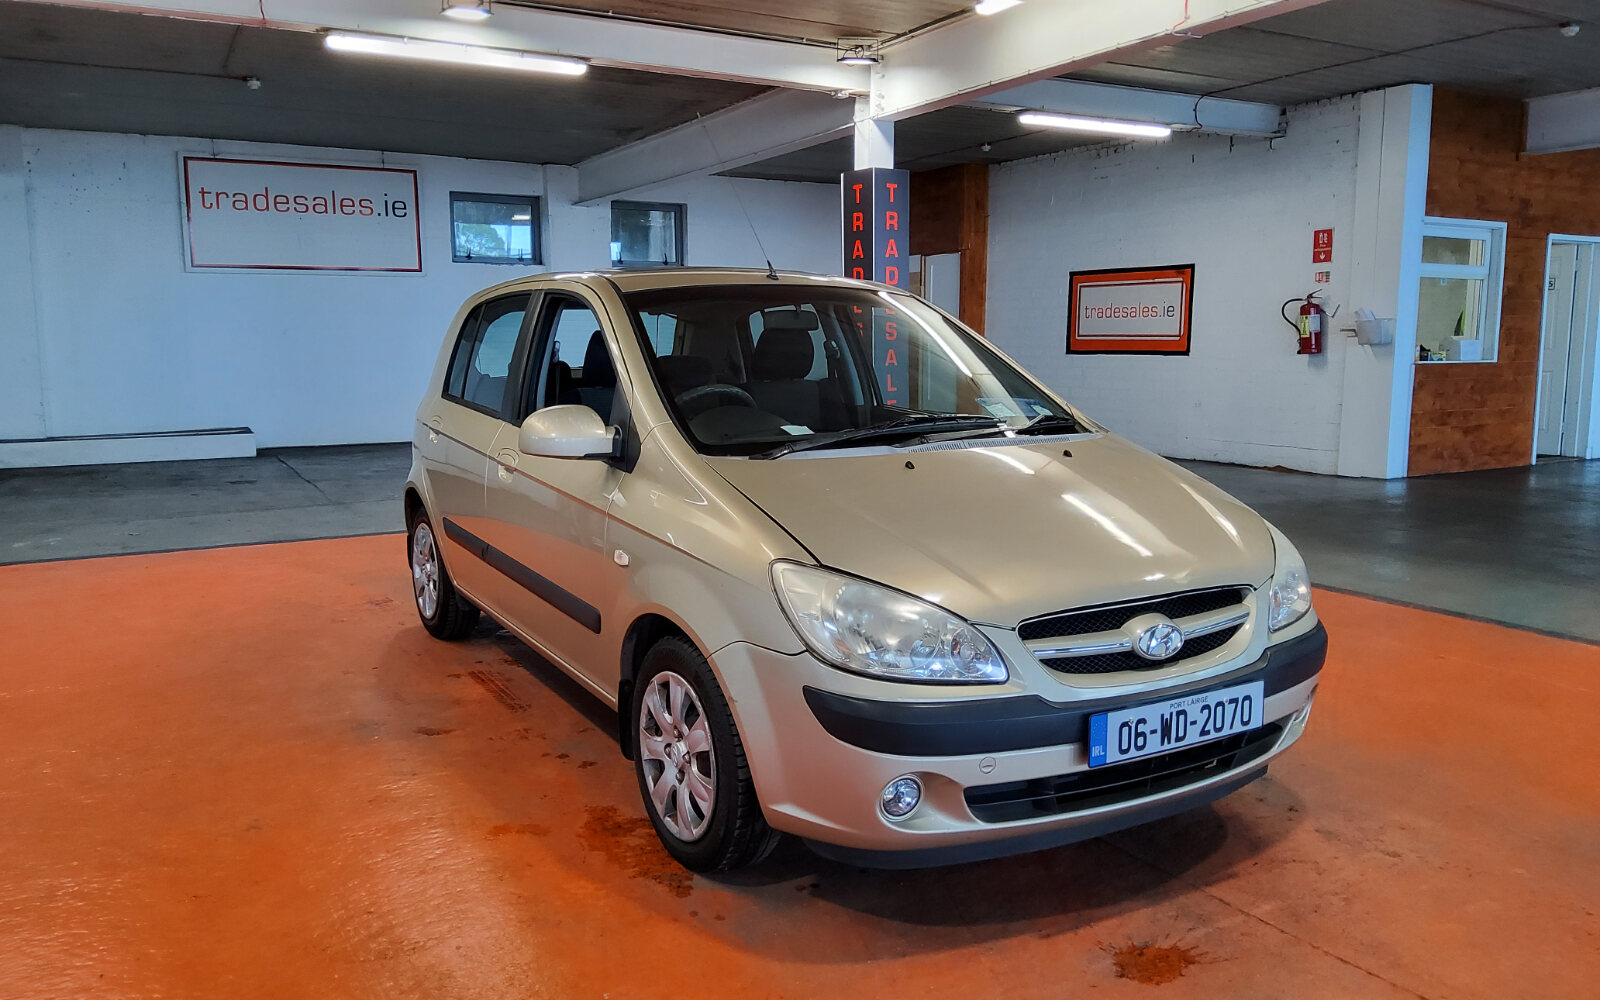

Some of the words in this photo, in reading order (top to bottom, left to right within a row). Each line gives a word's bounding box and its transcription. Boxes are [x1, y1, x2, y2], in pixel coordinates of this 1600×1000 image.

[198, 186, 408, 218] tradesales.ie
[1084, 301, 1175, 319] tradesales.ie
[1169, 701, 1186, 710] PORT
[1118, 695, 1252, 755] 06-WD-2070
[1091, 745, 1105, 757] IRL
